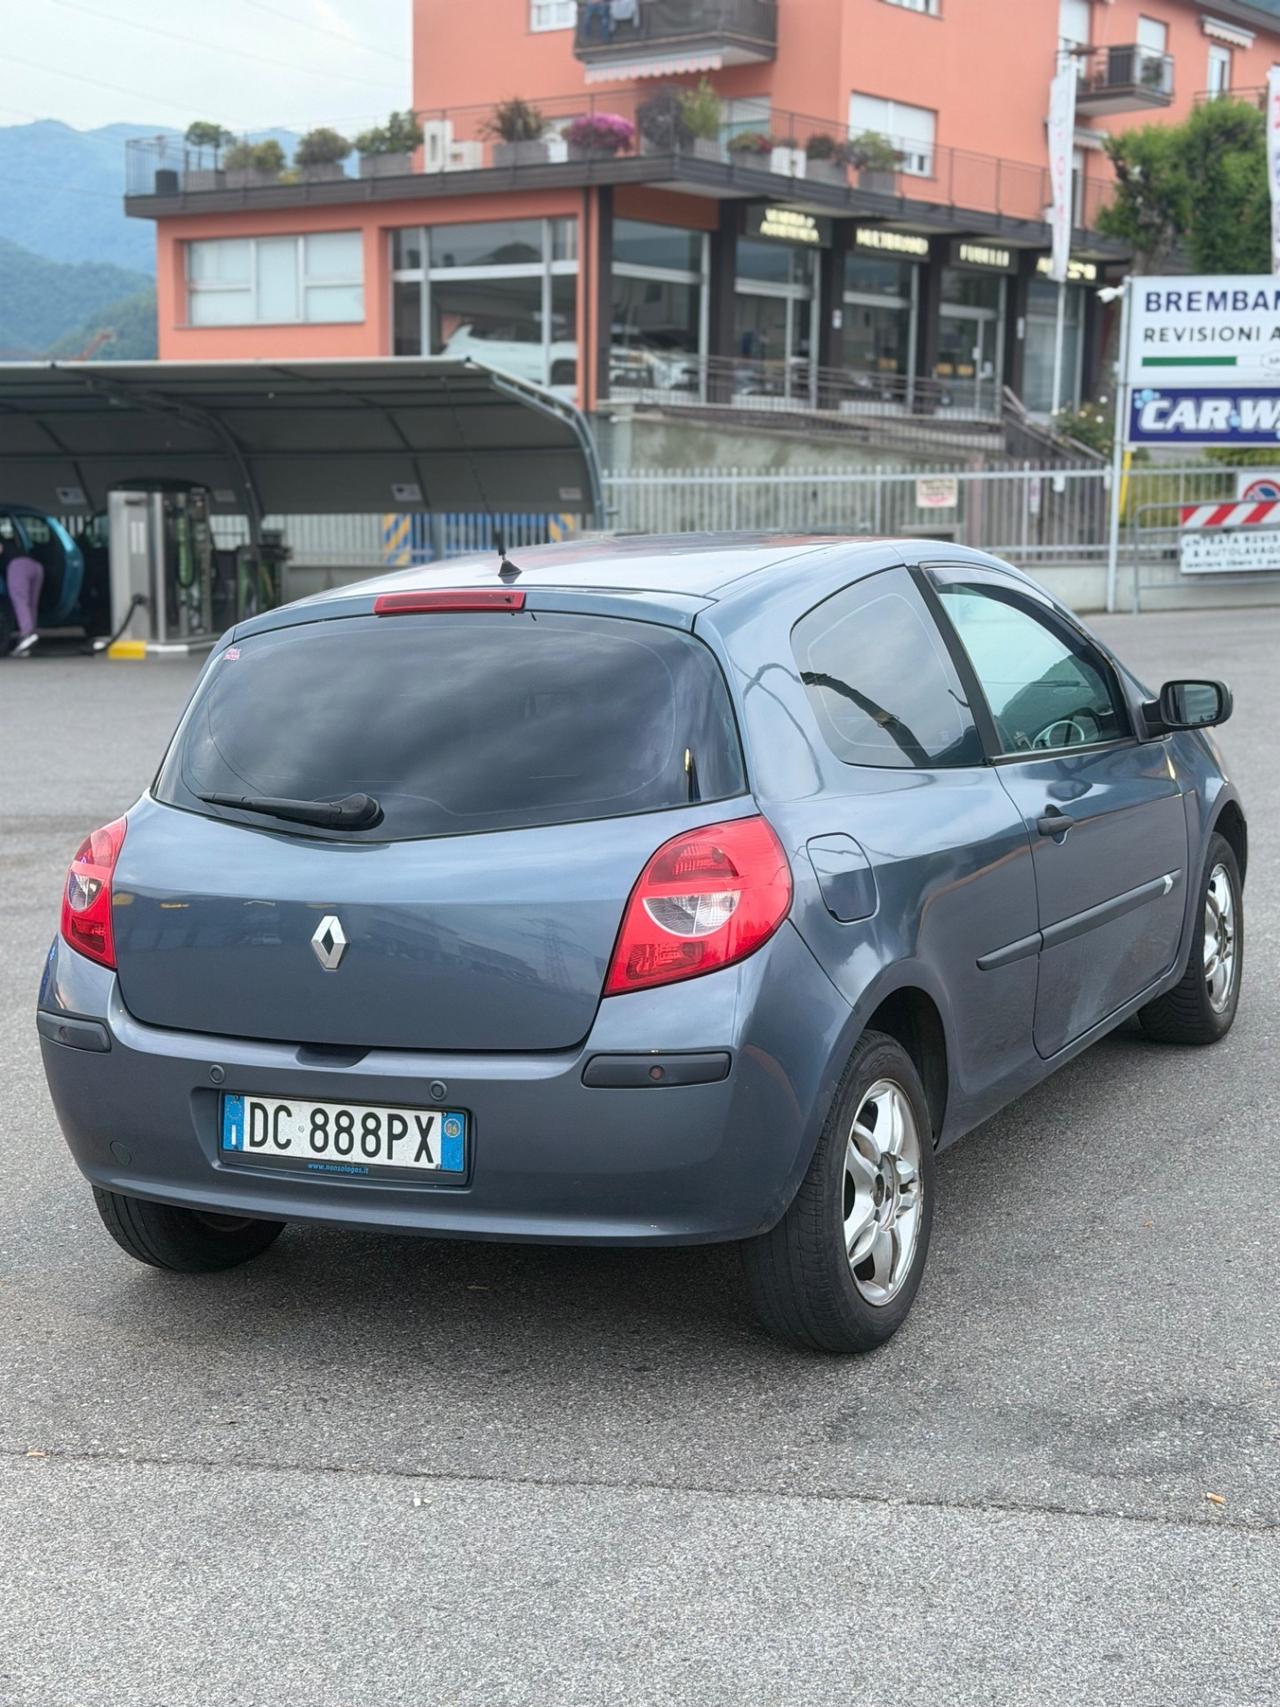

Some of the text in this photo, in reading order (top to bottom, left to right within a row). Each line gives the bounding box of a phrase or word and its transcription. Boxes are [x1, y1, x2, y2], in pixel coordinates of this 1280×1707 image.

[1143, 326, 1261, 342] REVISIONI
[1139, 398, 1233, 431] CAR
[249, 1101, 435, 1164] DC 888PX
